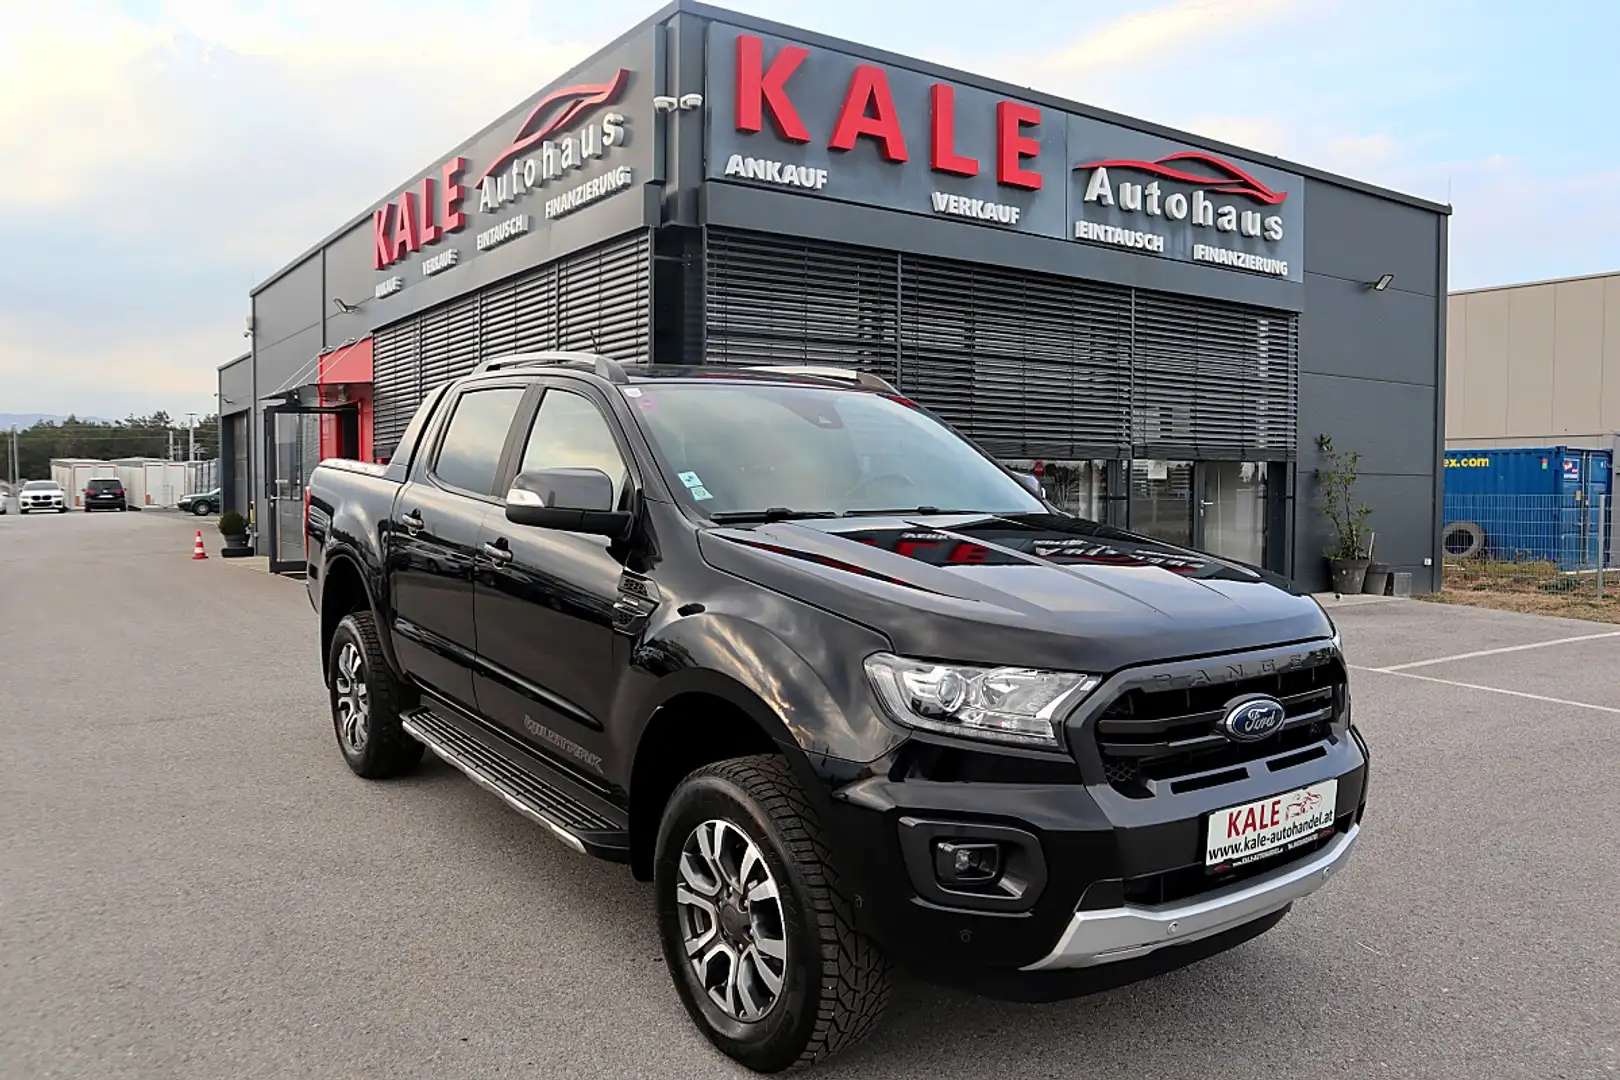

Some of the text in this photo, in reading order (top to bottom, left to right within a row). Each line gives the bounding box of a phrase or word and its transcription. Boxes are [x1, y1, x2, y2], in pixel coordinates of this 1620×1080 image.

[735, 33, 1043, 190] KALE
[478, 111, 625, 213] Autohaus
[724, 153, 1021, 225] ANKAUF VERKAUF
[373, 156, 466, 270] KALE
[476, 213, 530, 251] EINTAUSCH
[545, 165, 633, 220] FINANZIERUNG
[1084, 166, 1284, 242] Autohaus
[1075, 219, 1289, 277] EINTAUSCH FINANZIERUNG
[1244, 707, 1277, 732] Ford
[1208, 809, 1334, 861] www.kale-autohandel.at
[1227, 799, 1282, 839] KALE
